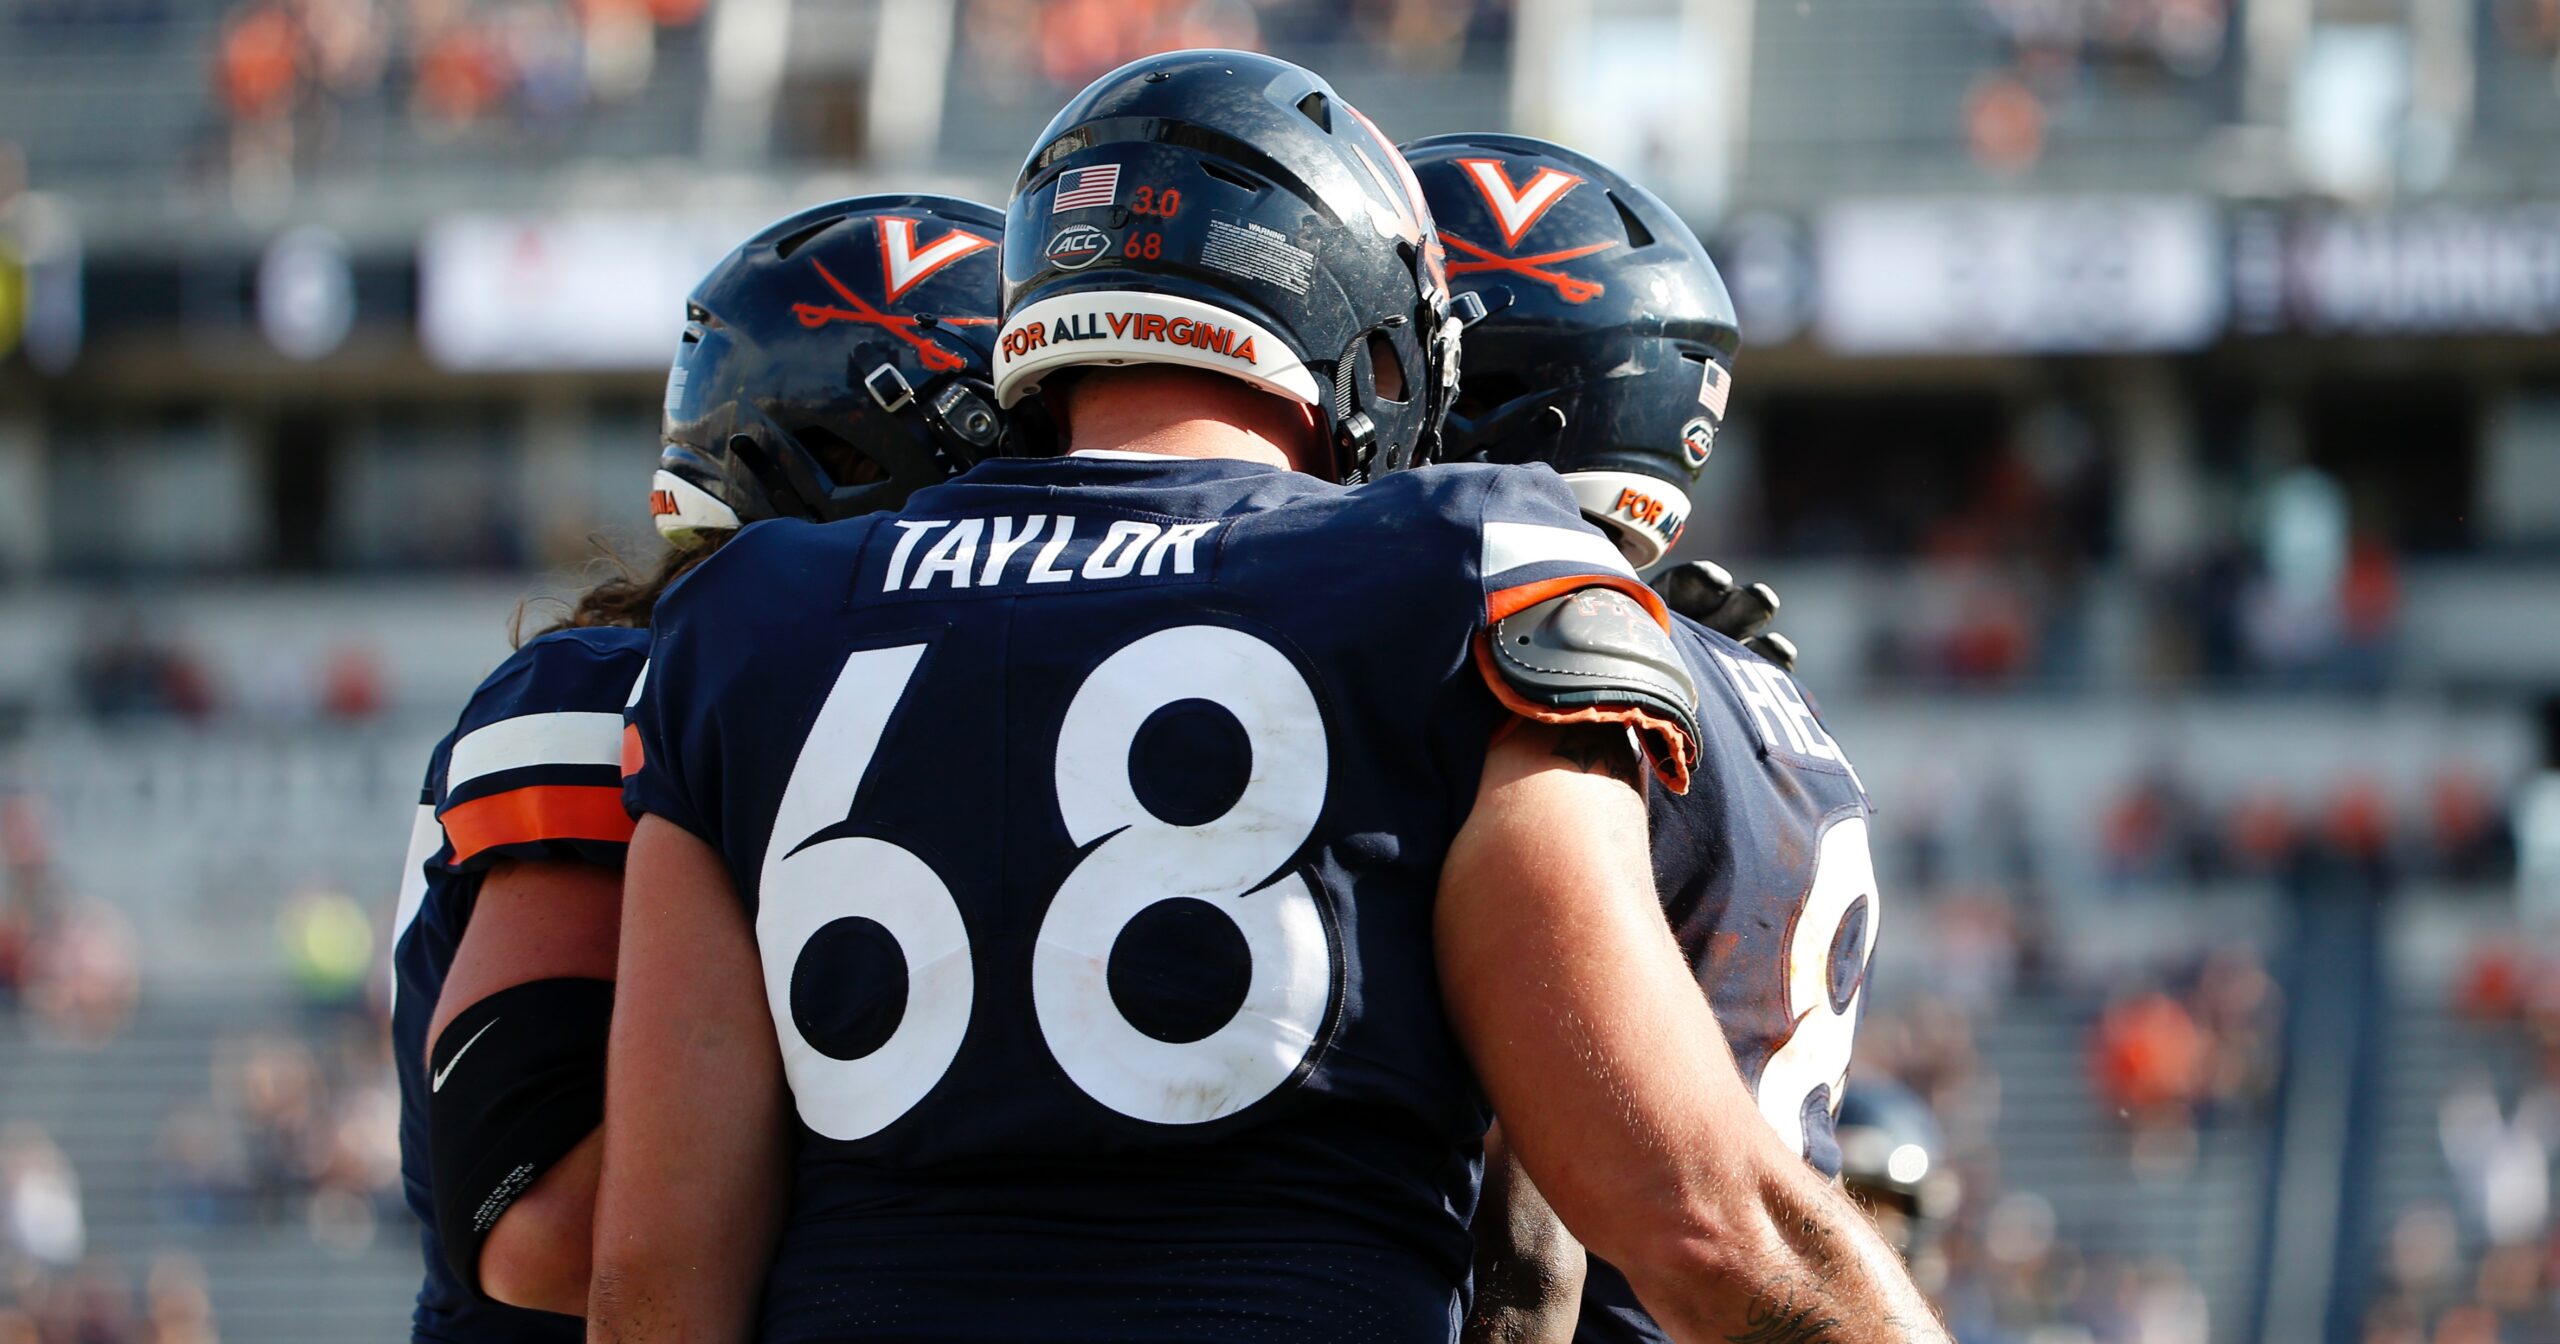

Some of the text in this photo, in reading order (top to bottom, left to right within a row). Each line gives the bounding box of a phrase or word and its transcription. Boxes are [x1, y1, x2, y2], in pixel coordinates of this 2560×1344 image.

[1132, 185, 1182, 218] 3.0
[1054, 232, 1101, 255] ACC
[1124, 231, 1162, 260] 68
[1248, 222, 1287, 242] WARNING
[1001, 311, 1258, 365] FOR ALL VIRGINIA
[1615, 487, 1664, 525] FOR
[883, 514, 1219, 592] TAYLOR
[1717, 652, 1865, 794] HE
[756, 623, 1331, 1142] 68
